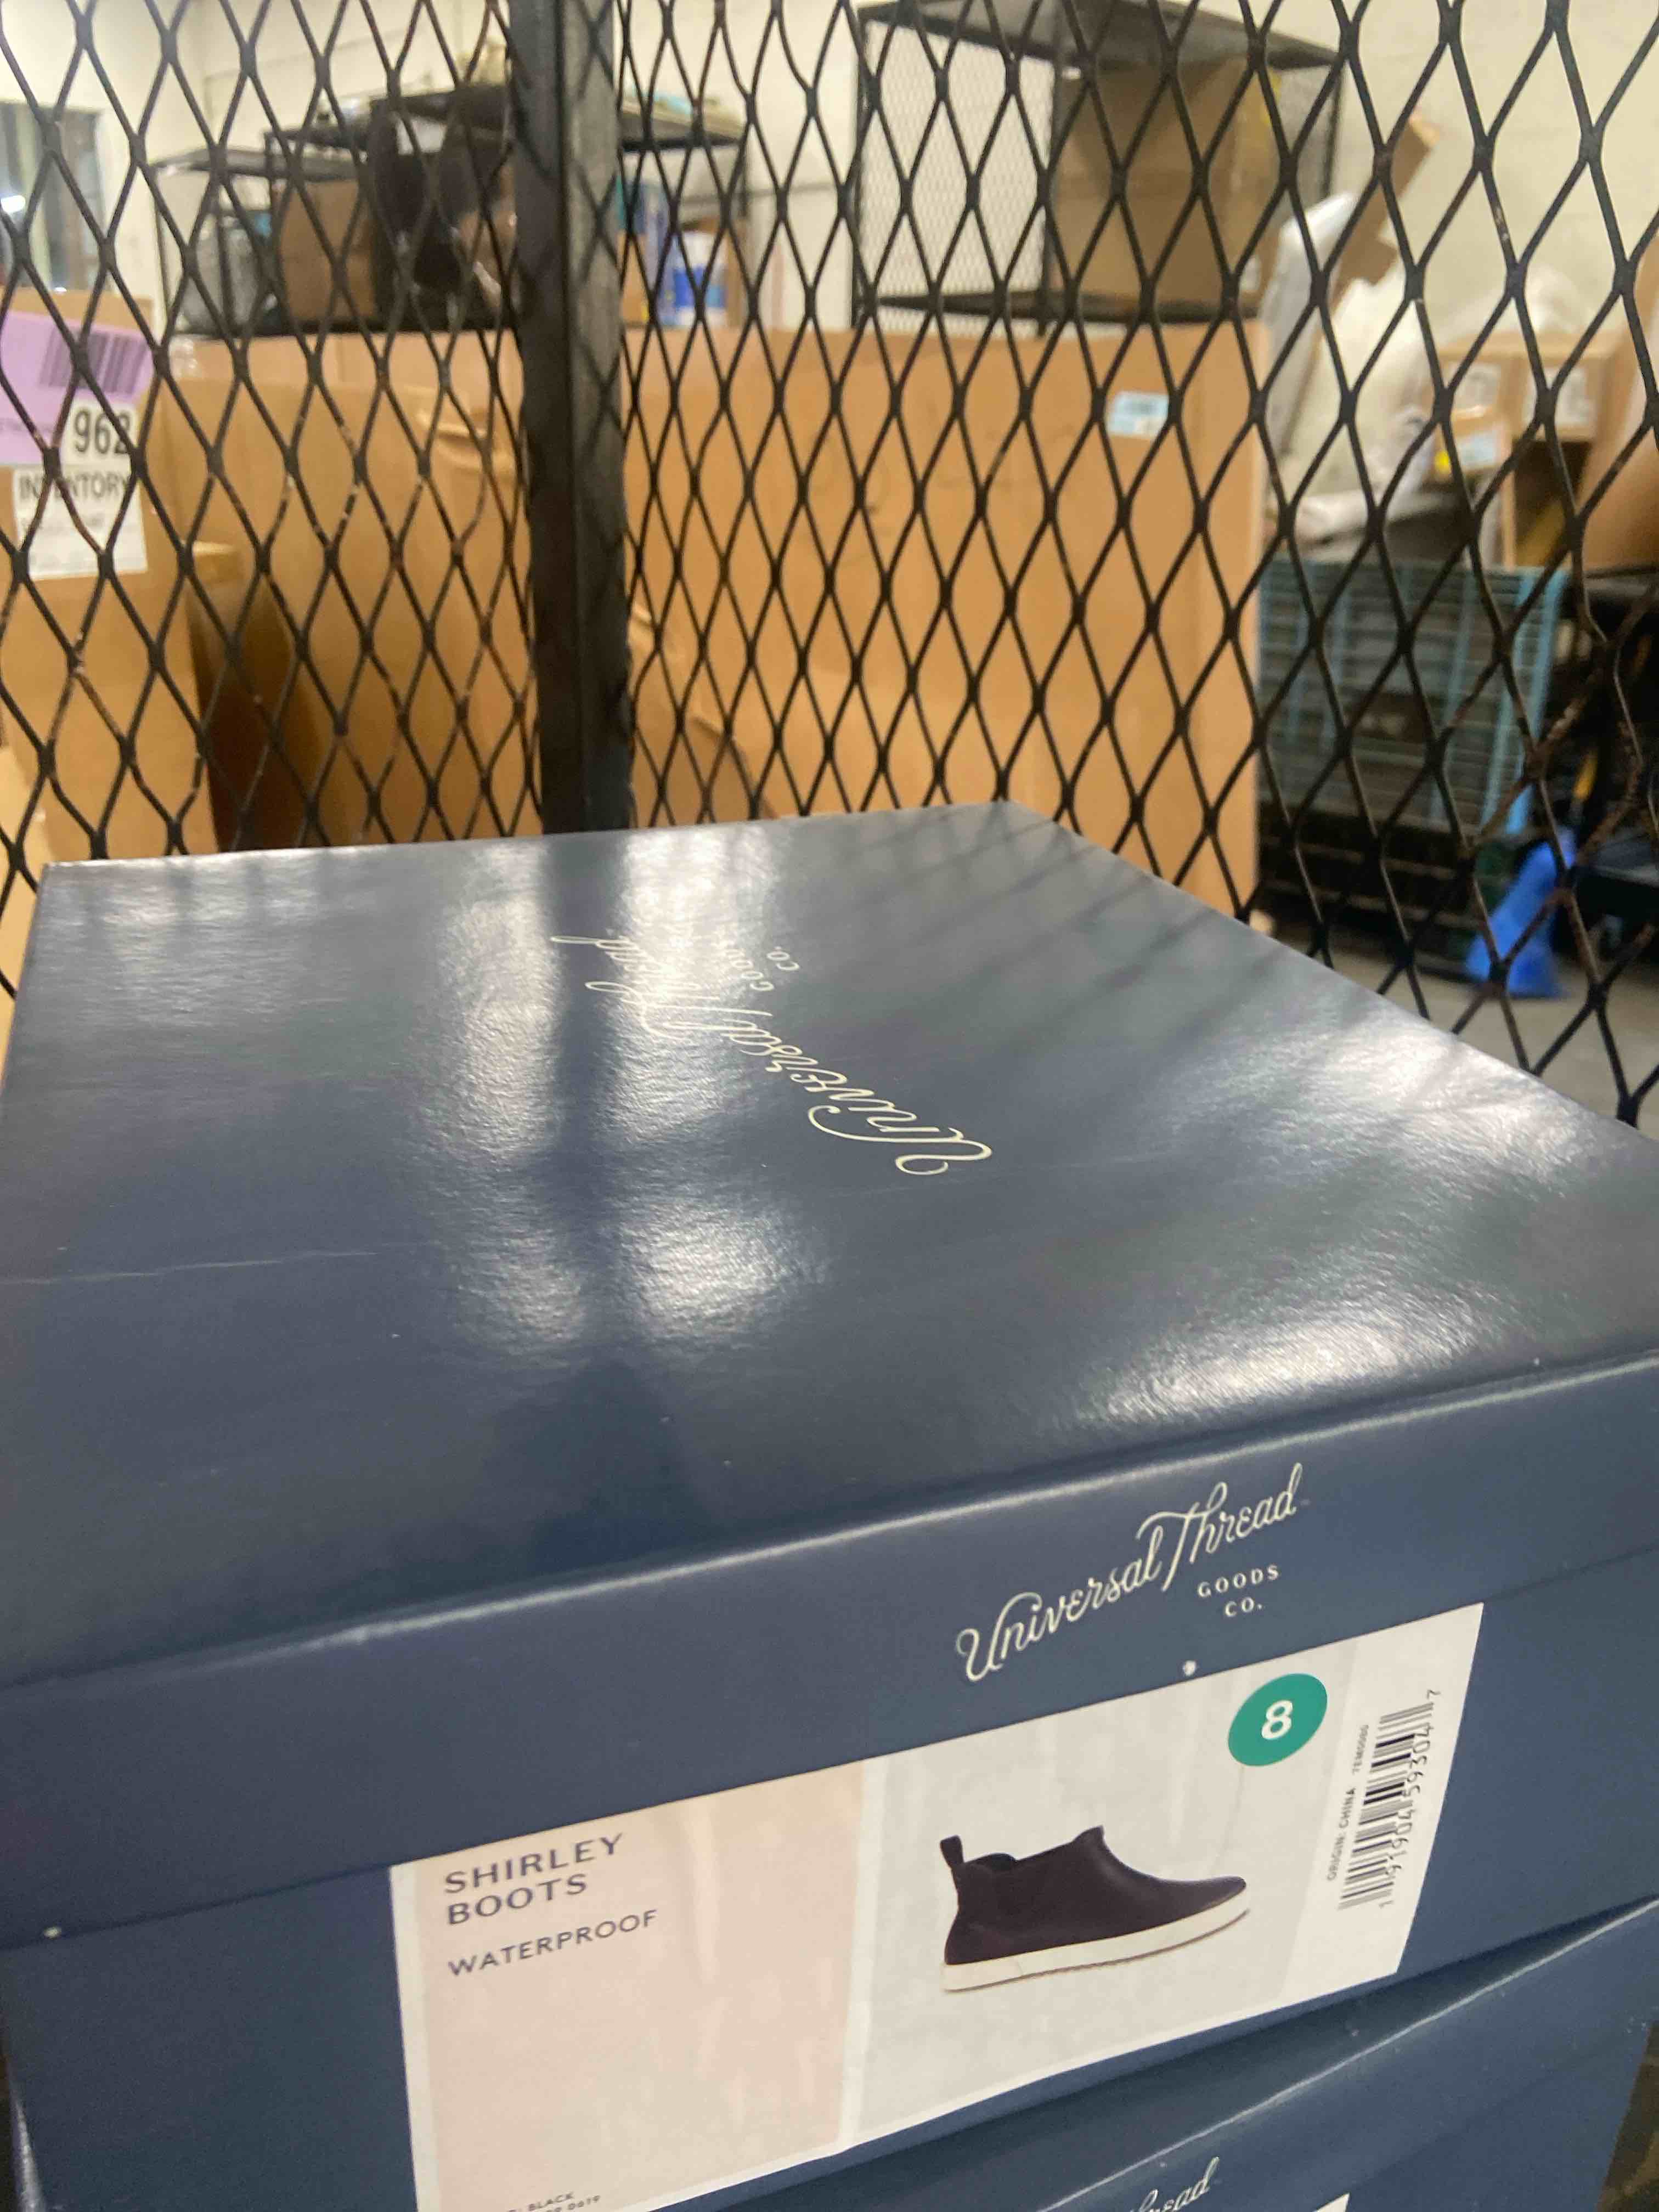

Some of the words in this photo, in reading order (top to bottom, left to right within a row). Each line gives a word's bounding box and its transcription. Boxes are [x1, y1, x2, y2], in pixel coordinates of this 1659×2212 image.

[75, 409, 131, 454] 962
[18, 471, 132, 500] INNTOR
[715, 938, 775, 991] GOOD
[662, 1018, 992, 1176] Universal
[956, 1524, 1163, 1681] Universal
[1136, 1462, 1303, 1592] Thread
[1198, 1564, 1280, 1598] GOODS
[1224, 1596, 1263, 1617] CO.
[1261, 1700, 1293, 1740] 8
[1338, 1787, 1357, 1829] CHINA
[445, 1832, 623, 1894] SHIRLEY
[448, 1873, 588, 1925] BOOTS
[448, 1909, 658, 1976] WATERPROOF
[528, 2191, 574, 2211] BLACK
[1130, 2156, 1220, 2212] head
